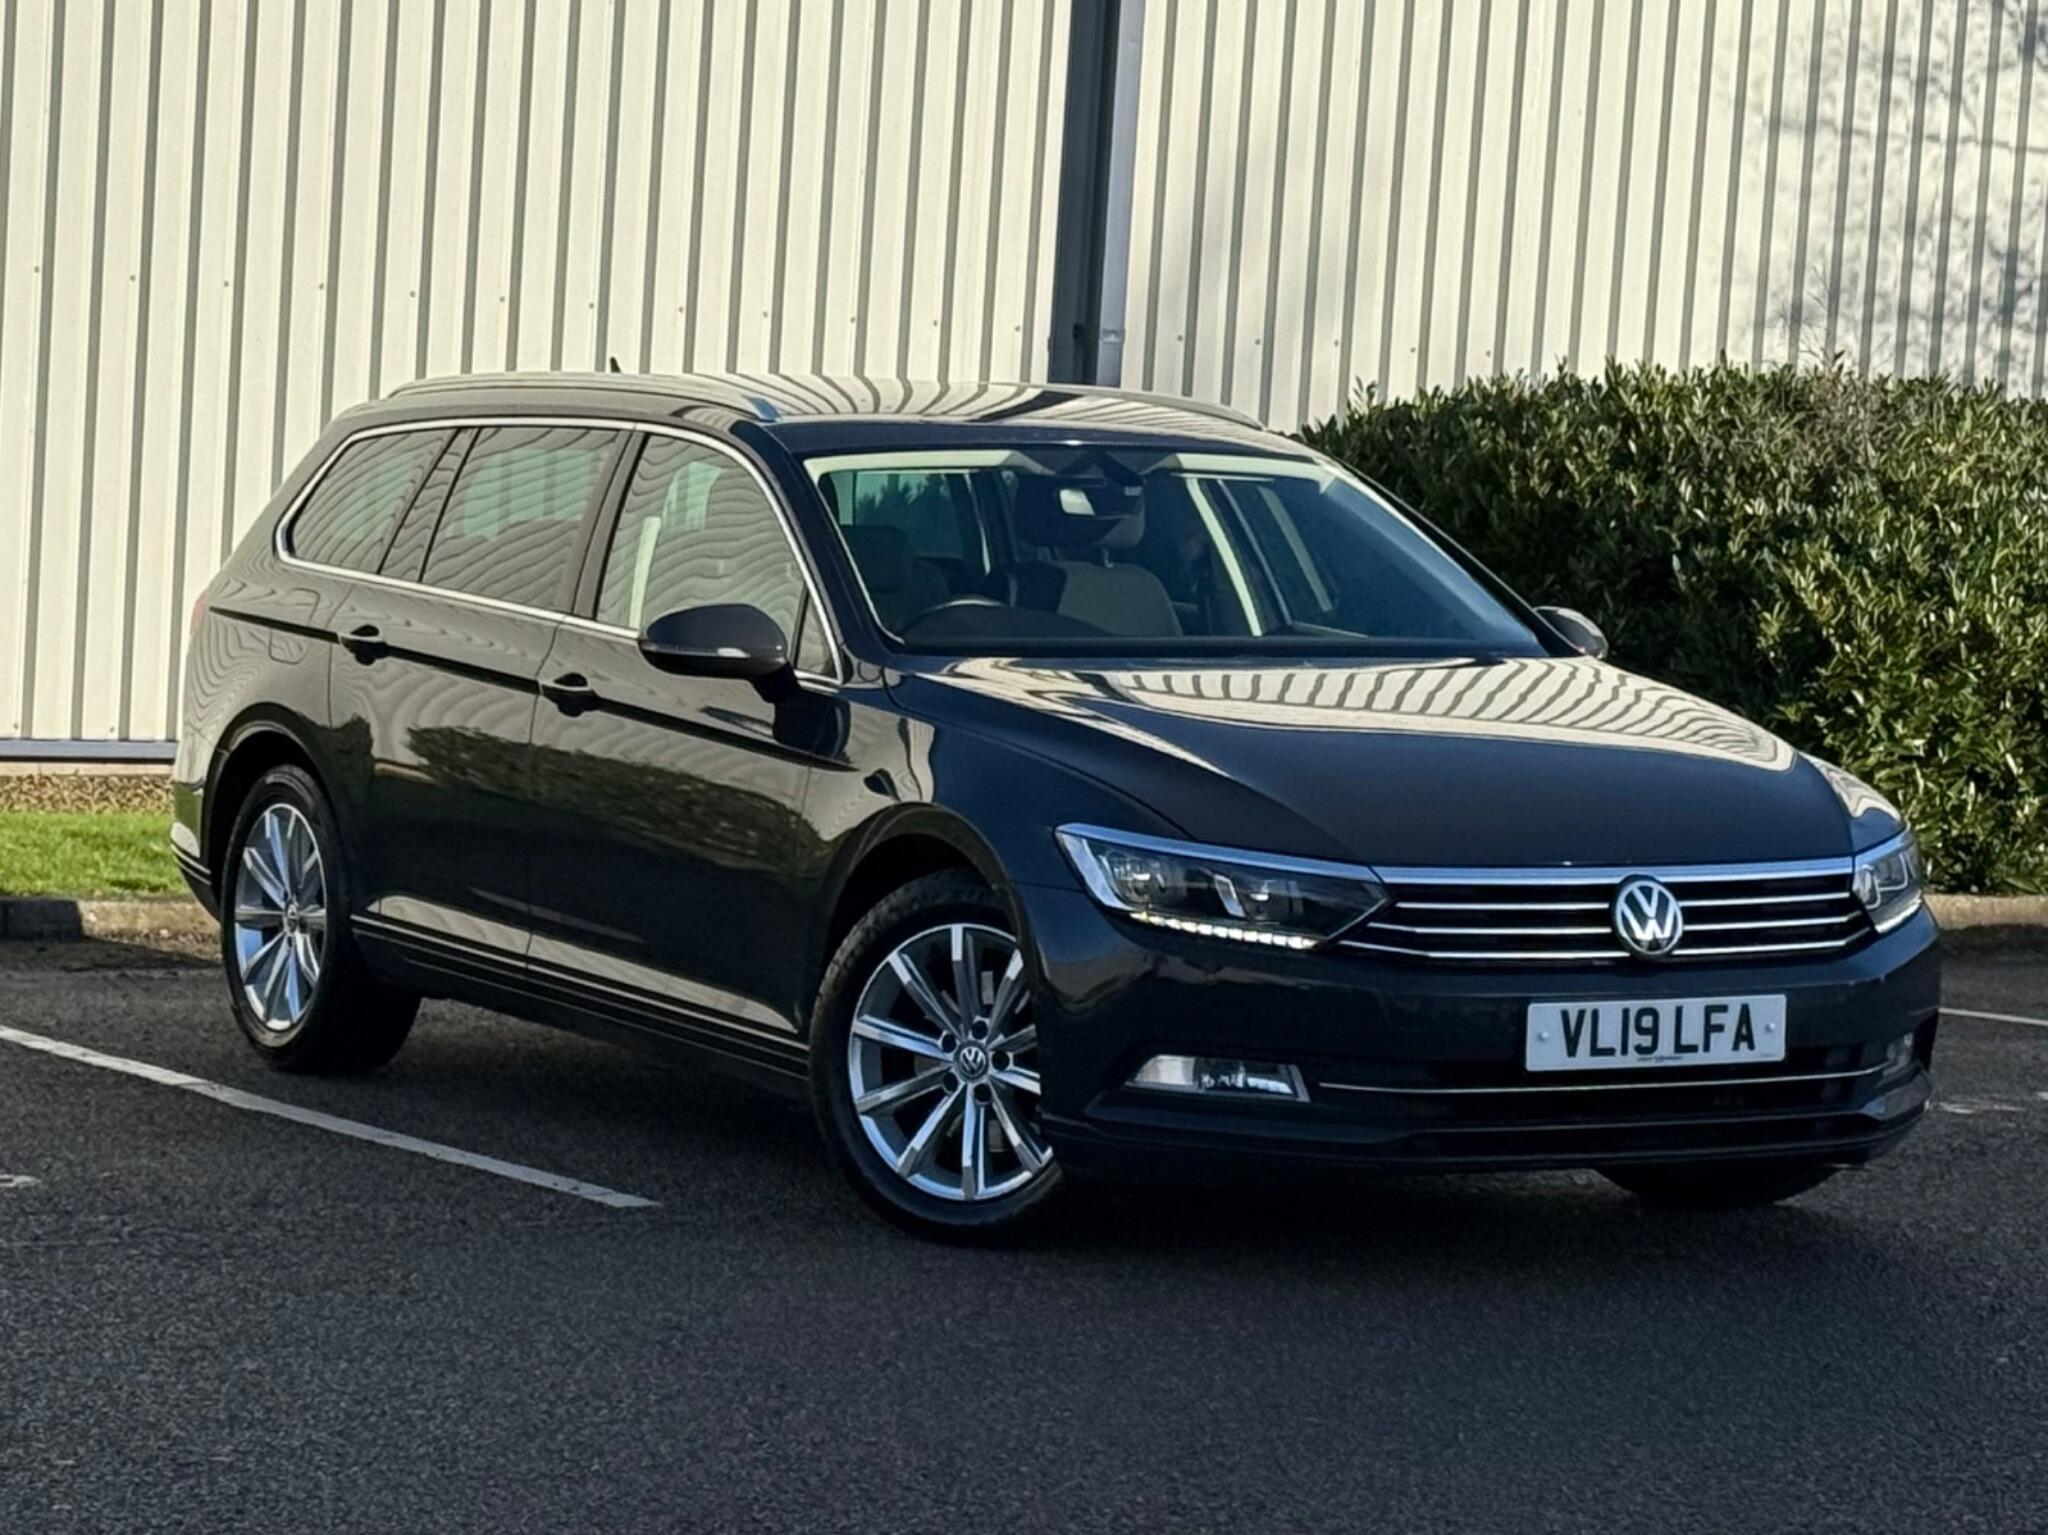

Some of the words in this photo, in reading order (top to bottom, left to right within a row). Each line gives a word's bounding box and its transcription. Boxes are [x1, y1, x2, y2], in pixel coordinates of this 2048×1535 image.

[1616, 880, 1683, 955] VW
[1560, 1007, 1660, 1058] VL19
[1673, 1003, 1756, 1054] LFA
